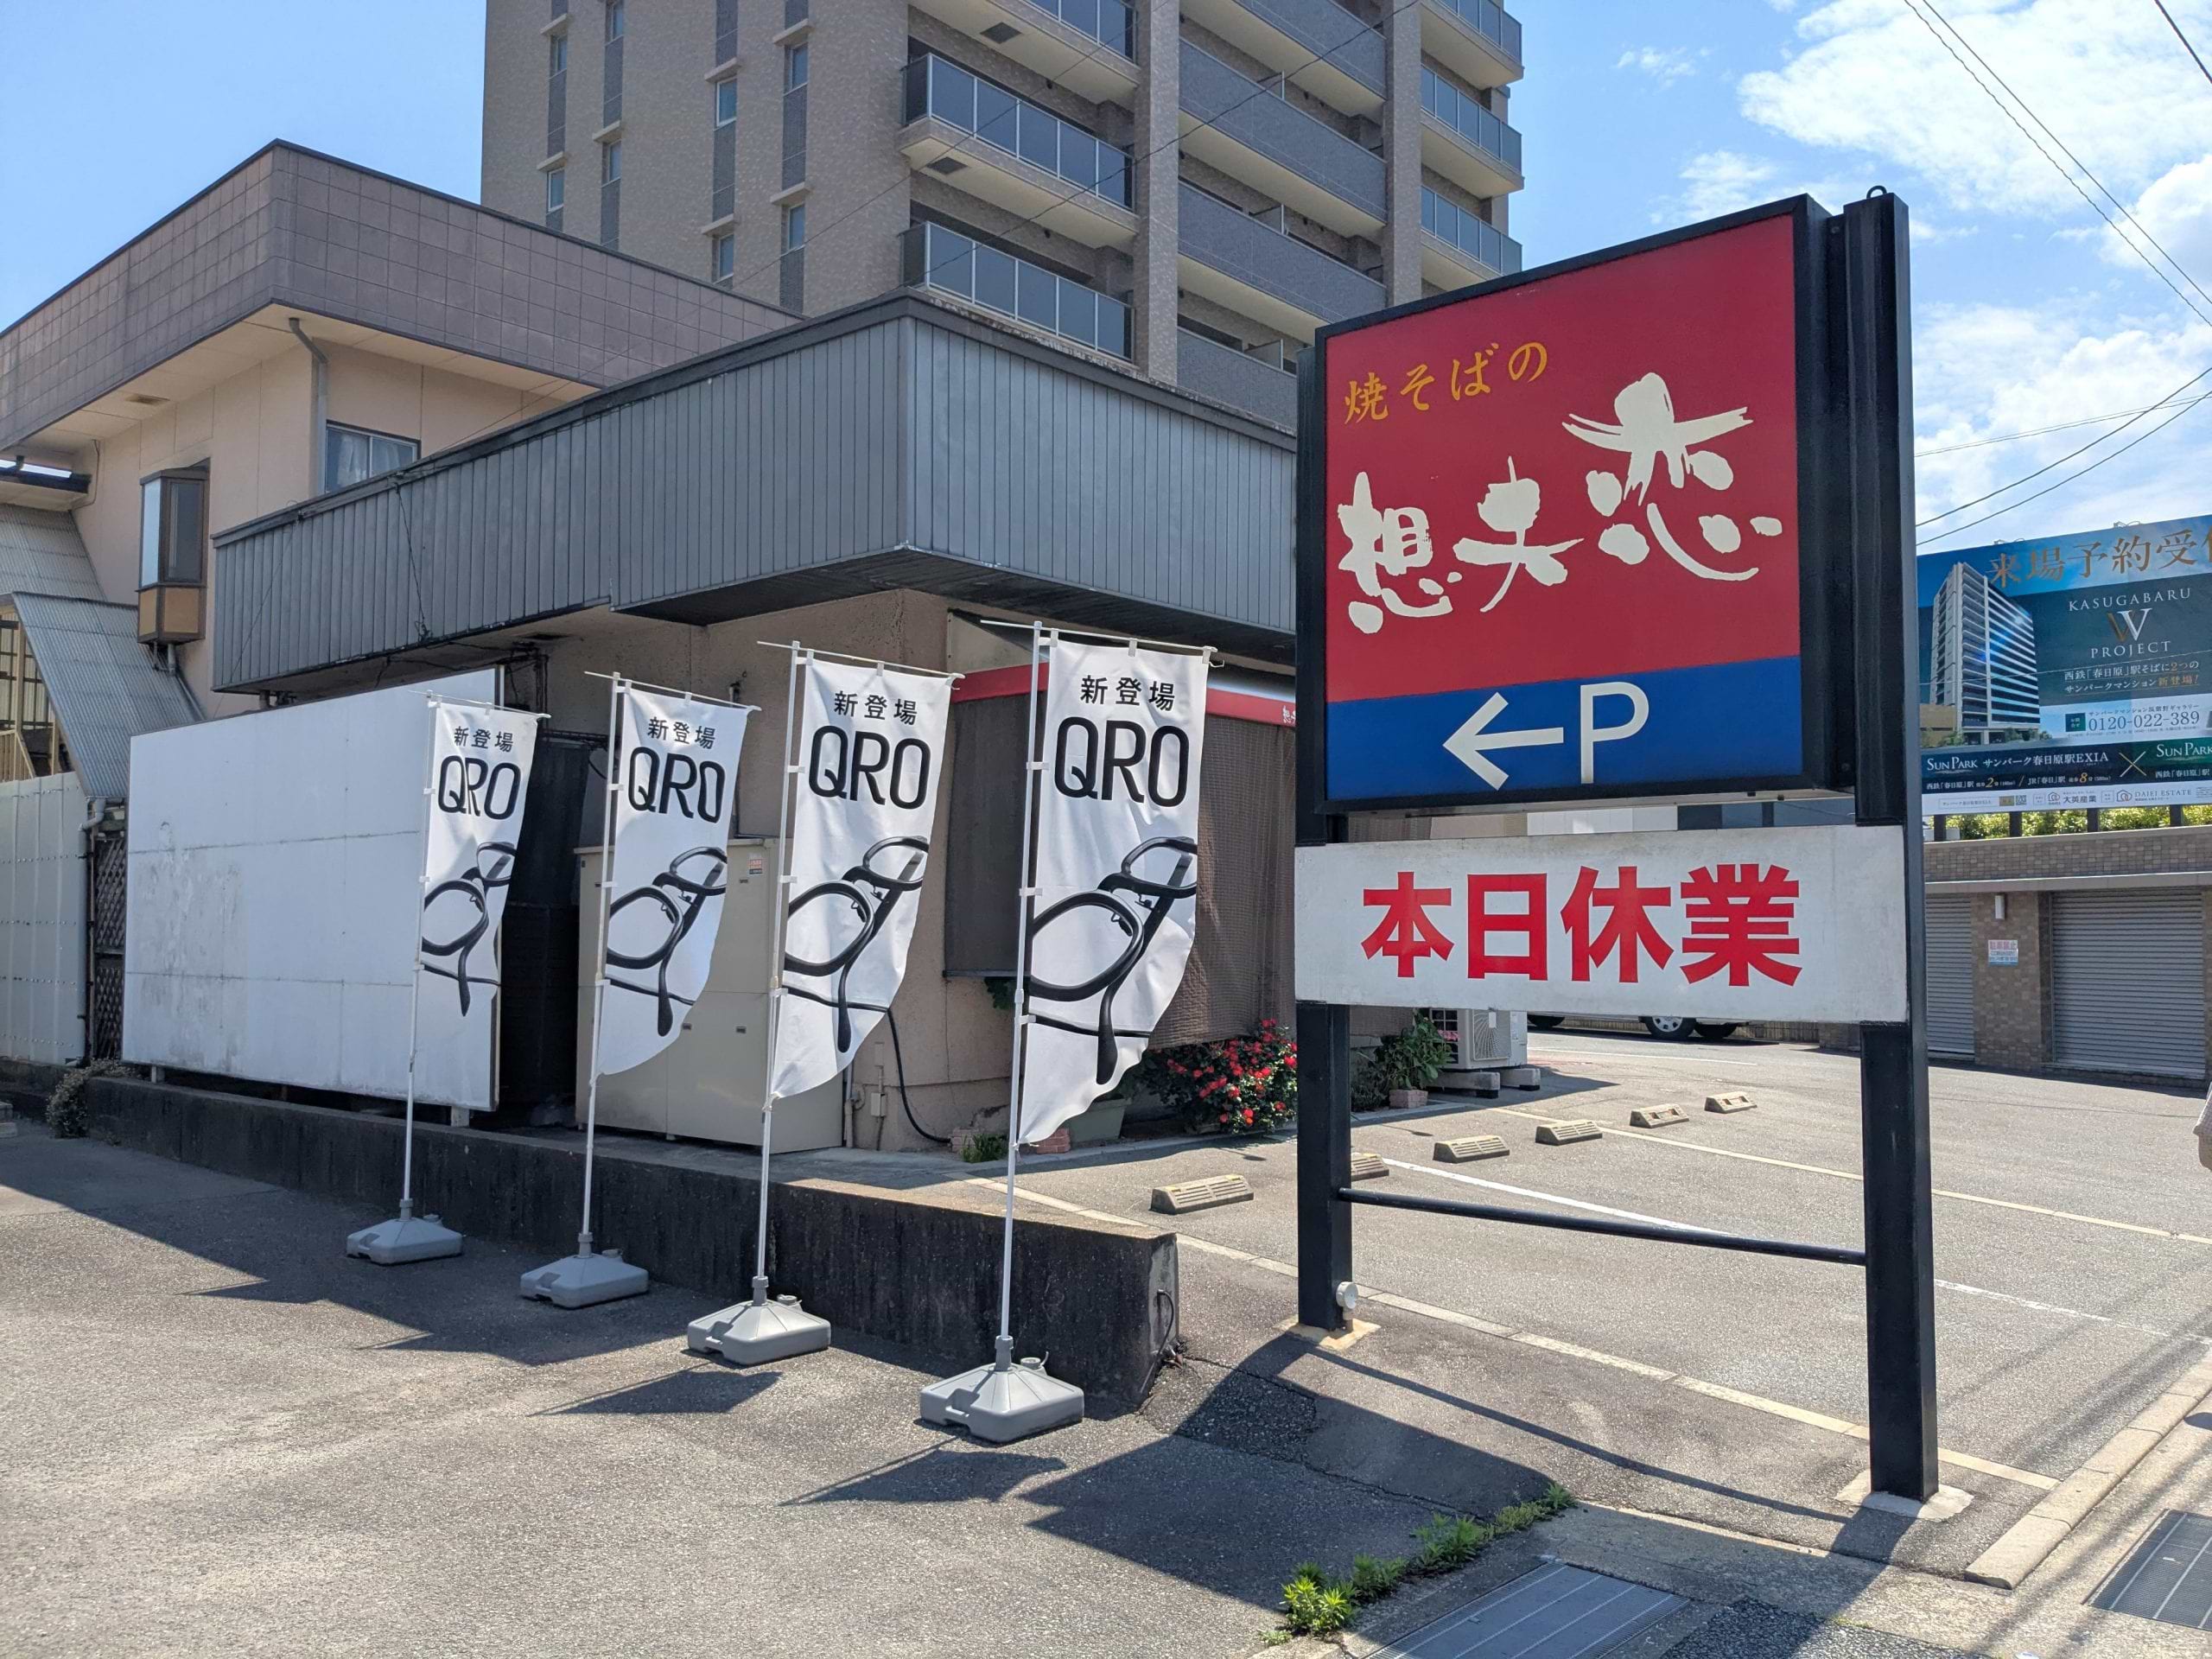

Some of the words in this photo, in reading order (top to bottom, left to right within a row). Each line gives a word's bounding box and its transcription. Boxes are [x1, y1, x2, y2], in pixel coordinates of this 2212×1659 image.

[1344, 341, 1548, 424] 焼そばの
[2069, 588, 2191, 612] KASUGABARU
[2091, 640, 2171, 658] PROJECT
[833, 690, 918, 727] 新登場
[1079, 674, 1176, 712] 新登場
[454, 726, 514, 753] 新登場
[647, 716, 716, 749] 新登場
[1580, 681, 1649, 784] P
[2088, 711, 2200, 731] 0120-022-389
[628, 747, 726, 823] QRO
[809, 725, 931, 810] QRO
[1053, 715, 1191, 808] QRO
[437, 755, 521, 820] QRO
[1361, 863, 1803, 987] 本日休業
